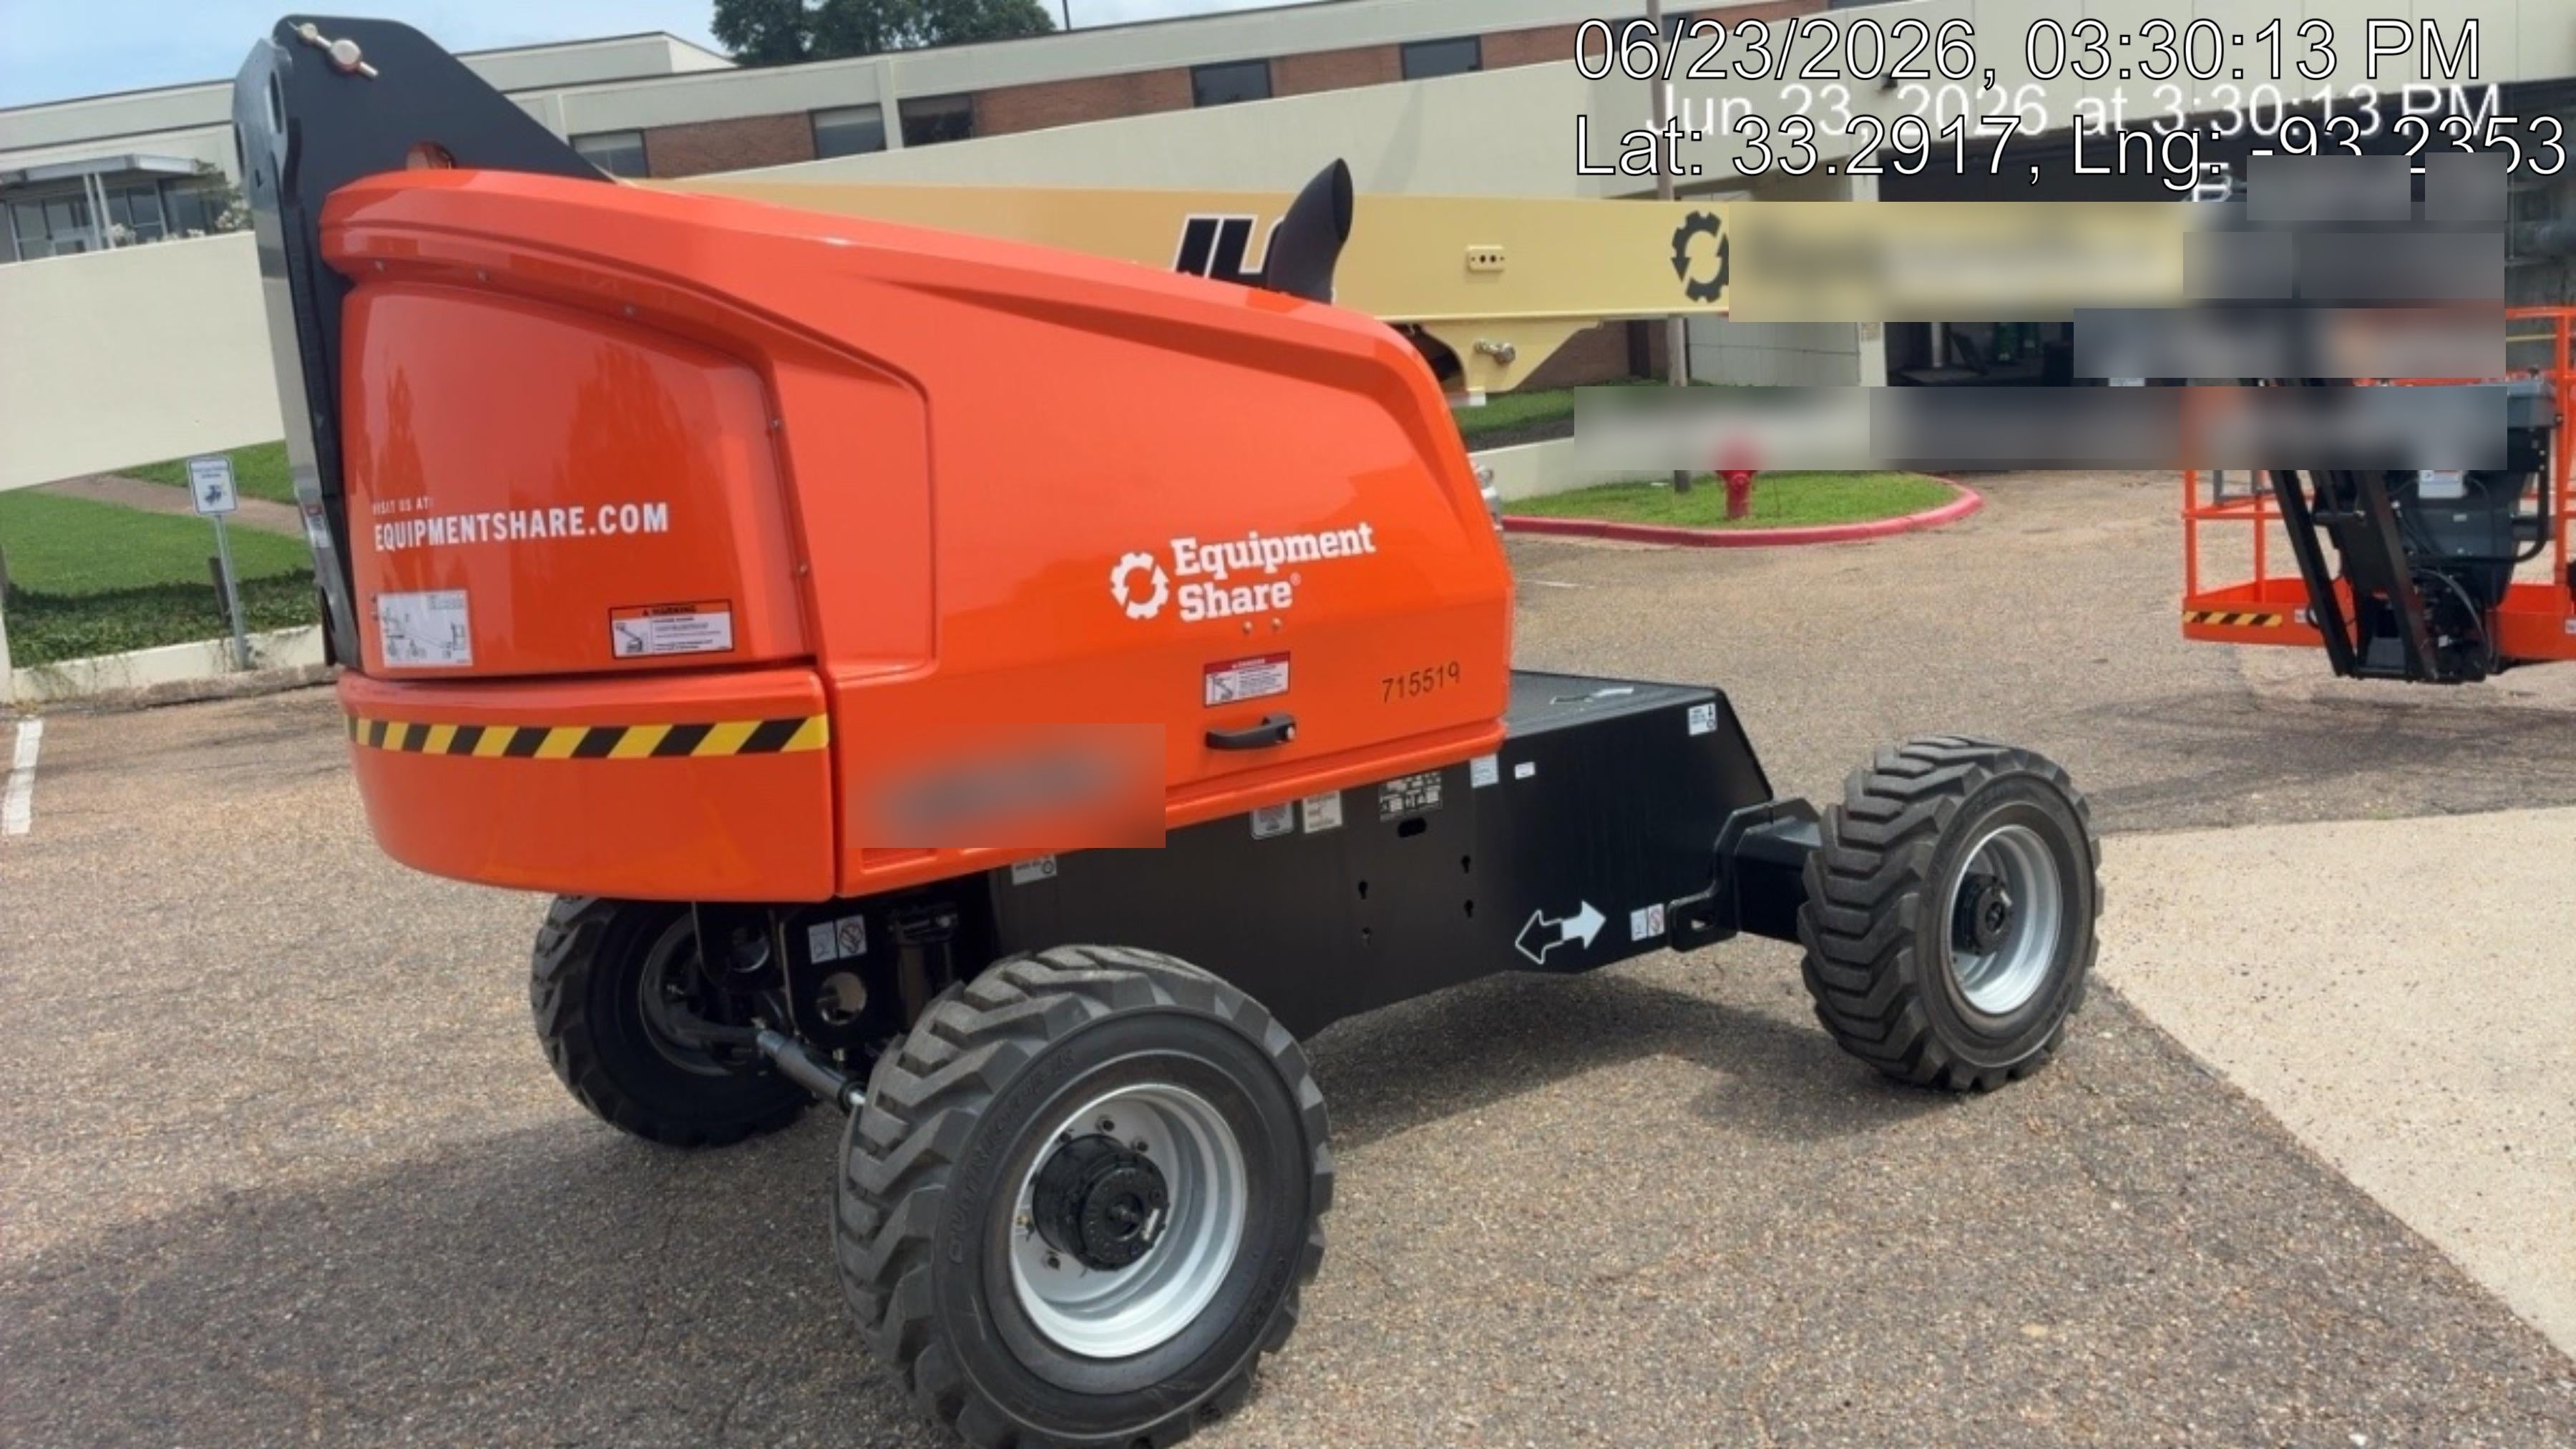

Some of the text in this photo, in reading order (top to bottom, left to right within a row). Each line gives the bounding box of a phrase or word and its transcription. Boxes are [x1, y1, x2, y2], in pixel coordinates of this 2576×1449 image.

[374, 502, 669, 553] EQUIPMENTSHARE.COM
[399, 497, 412, 512] US
[1170, 521, 1377, 581] Equipment
[1382, 660, 1460, 703] 715519
